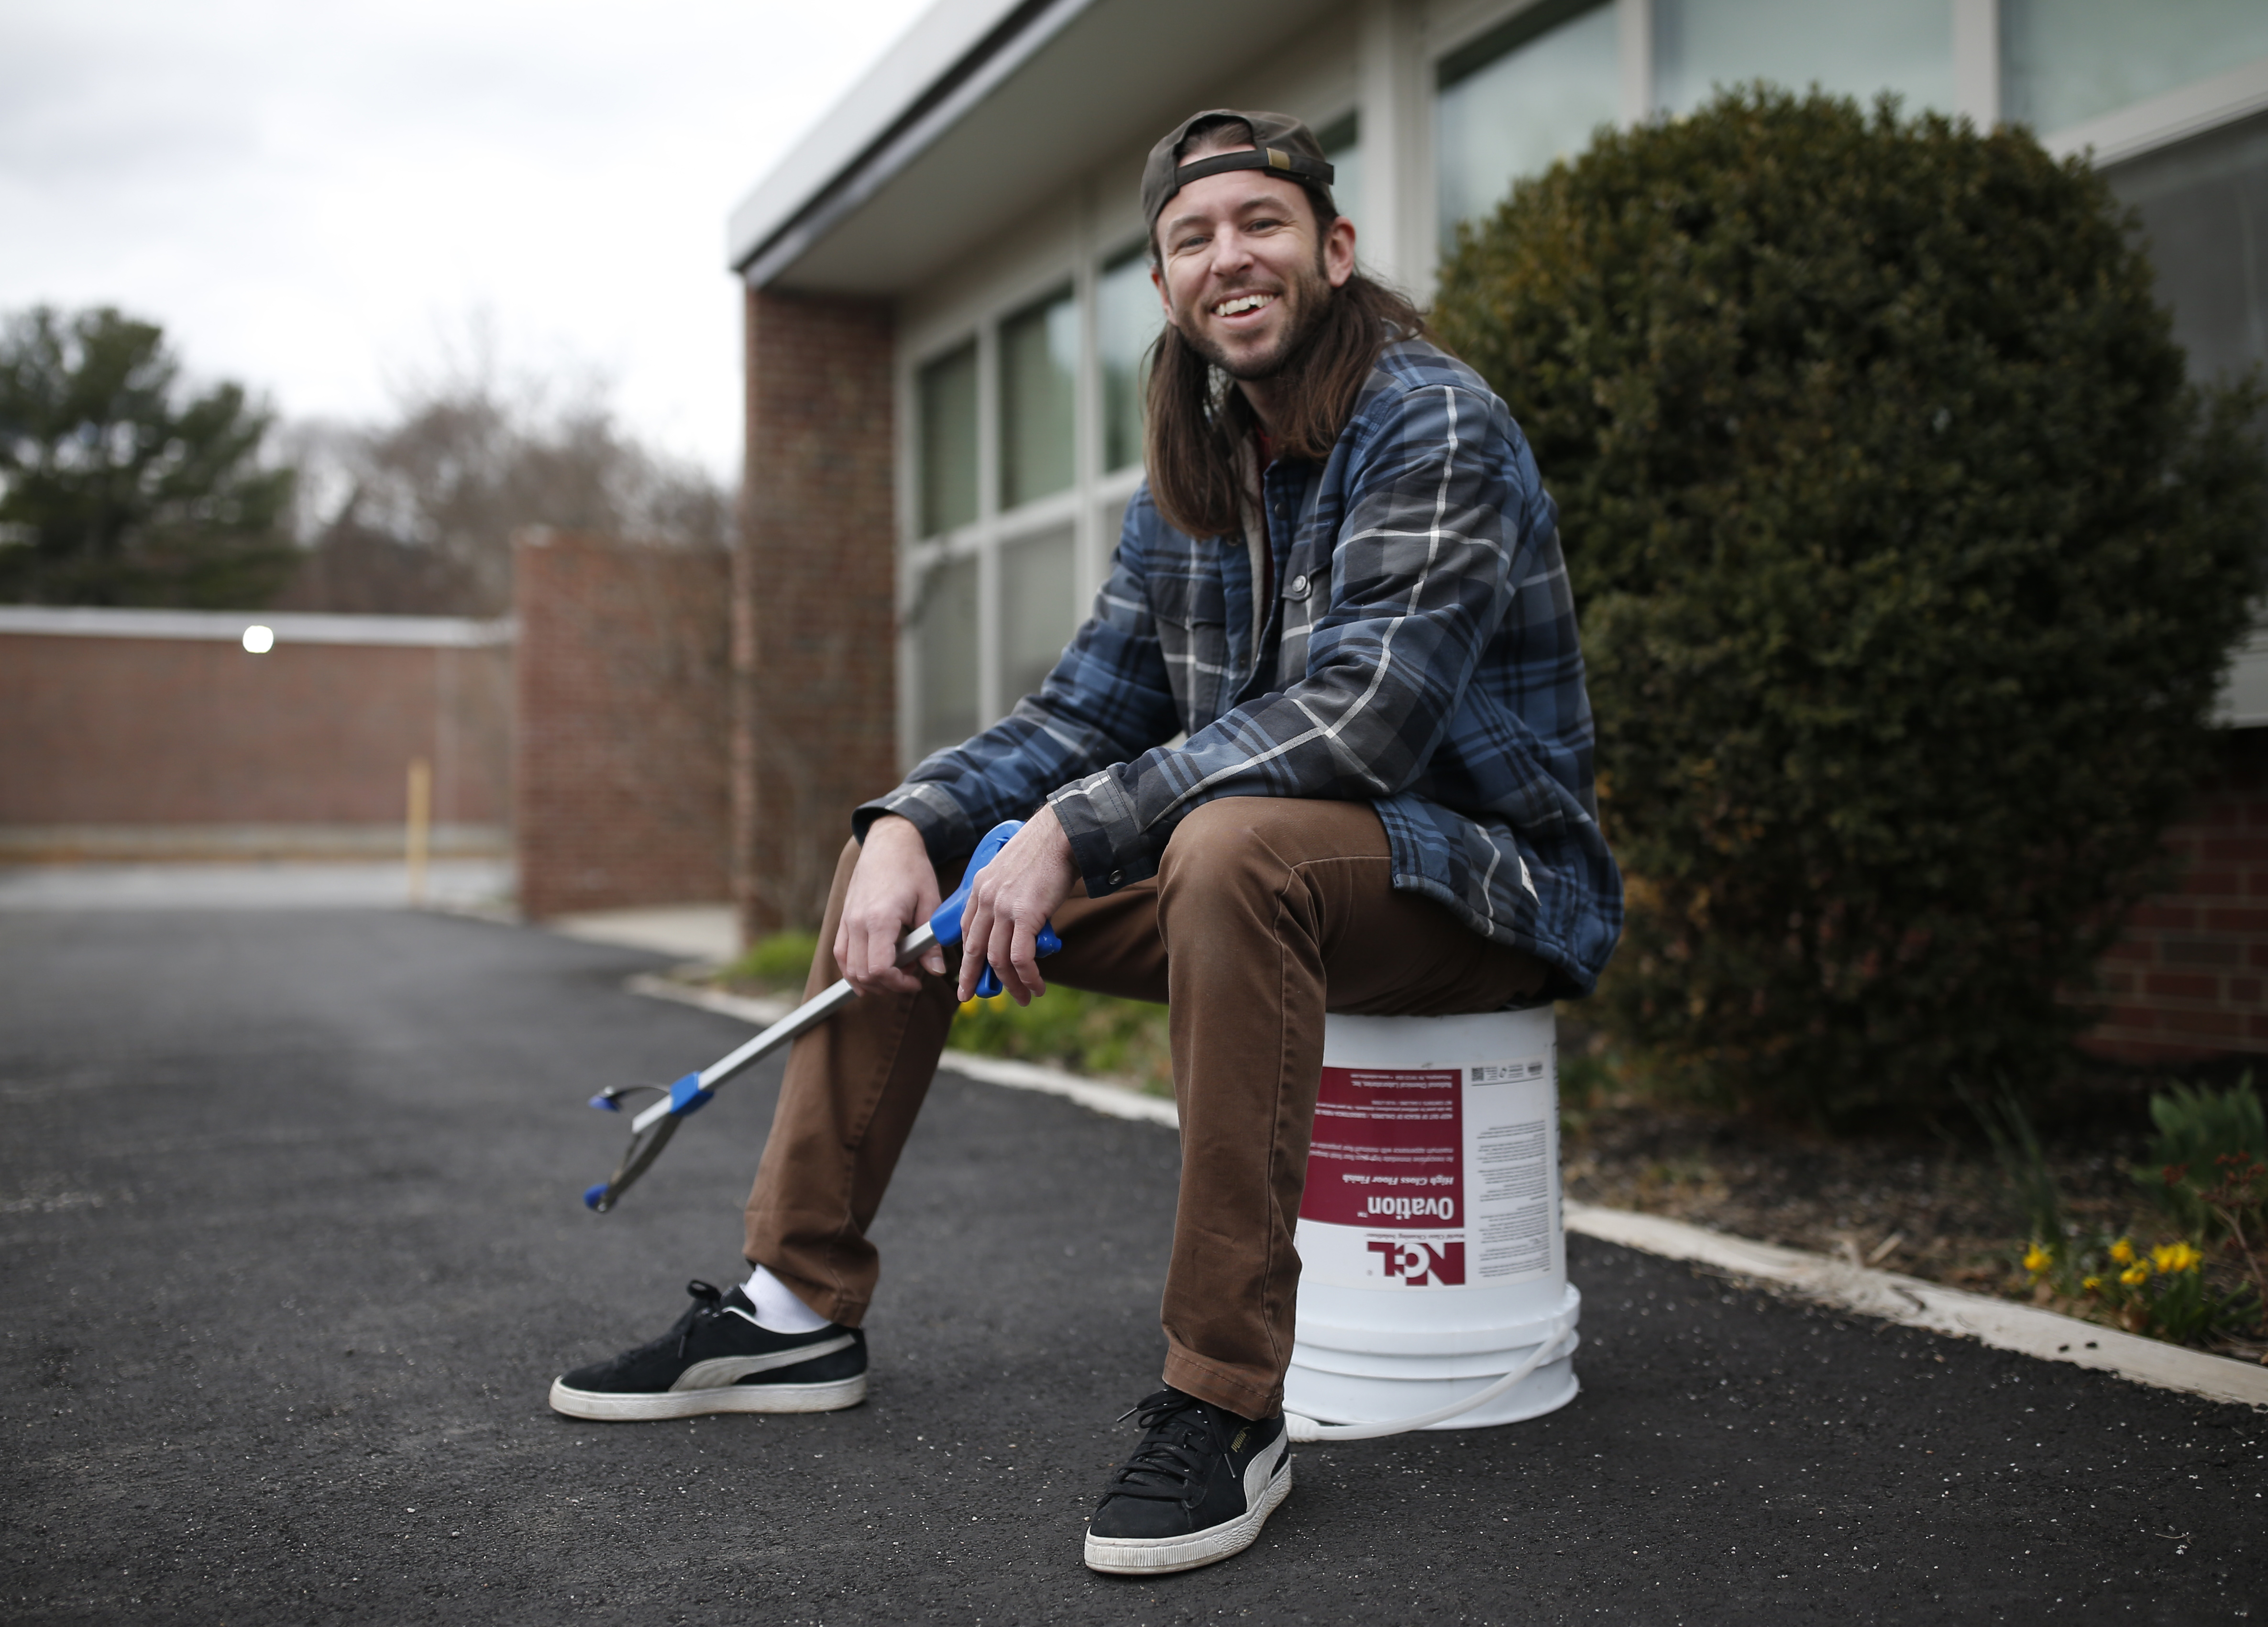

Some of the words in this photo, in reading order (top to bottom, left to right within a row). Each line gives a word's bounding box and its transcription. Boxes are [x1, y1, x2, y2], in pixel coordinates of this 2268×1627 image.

[1343, 1175, 1370, 1184] Finish
[1372, 1176, 1398, 1185] Floor
[1400, 1177, 1428, 1186] Gloss
[1430, 1175, 1454, 1185] High
[1231, 1427, 1247, 1452] PUMA
